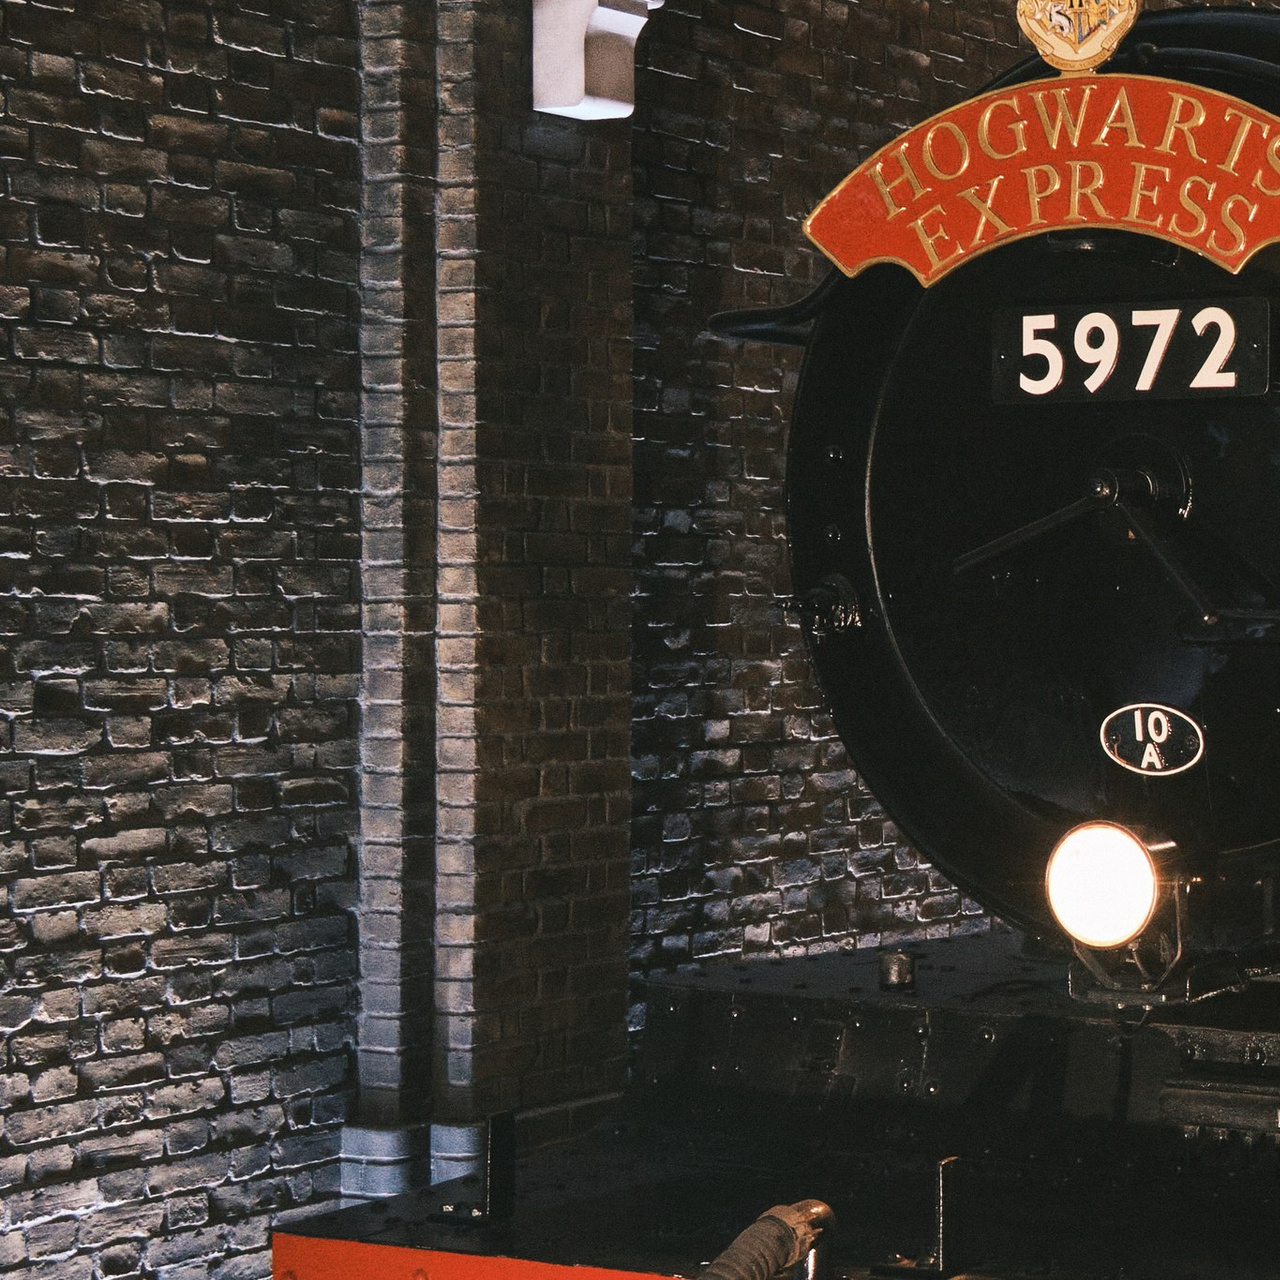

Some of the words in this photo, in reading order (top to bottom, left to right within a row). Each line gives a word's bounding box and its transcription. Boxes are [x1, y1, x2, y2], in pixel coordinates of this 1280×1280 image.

[906, 160, 1259, 273] EXPRESS
[1019, 307, 1238, 395] 5972
[1134, 709, 1169, 743] 10
[1140, 743, 1163, 769] A
